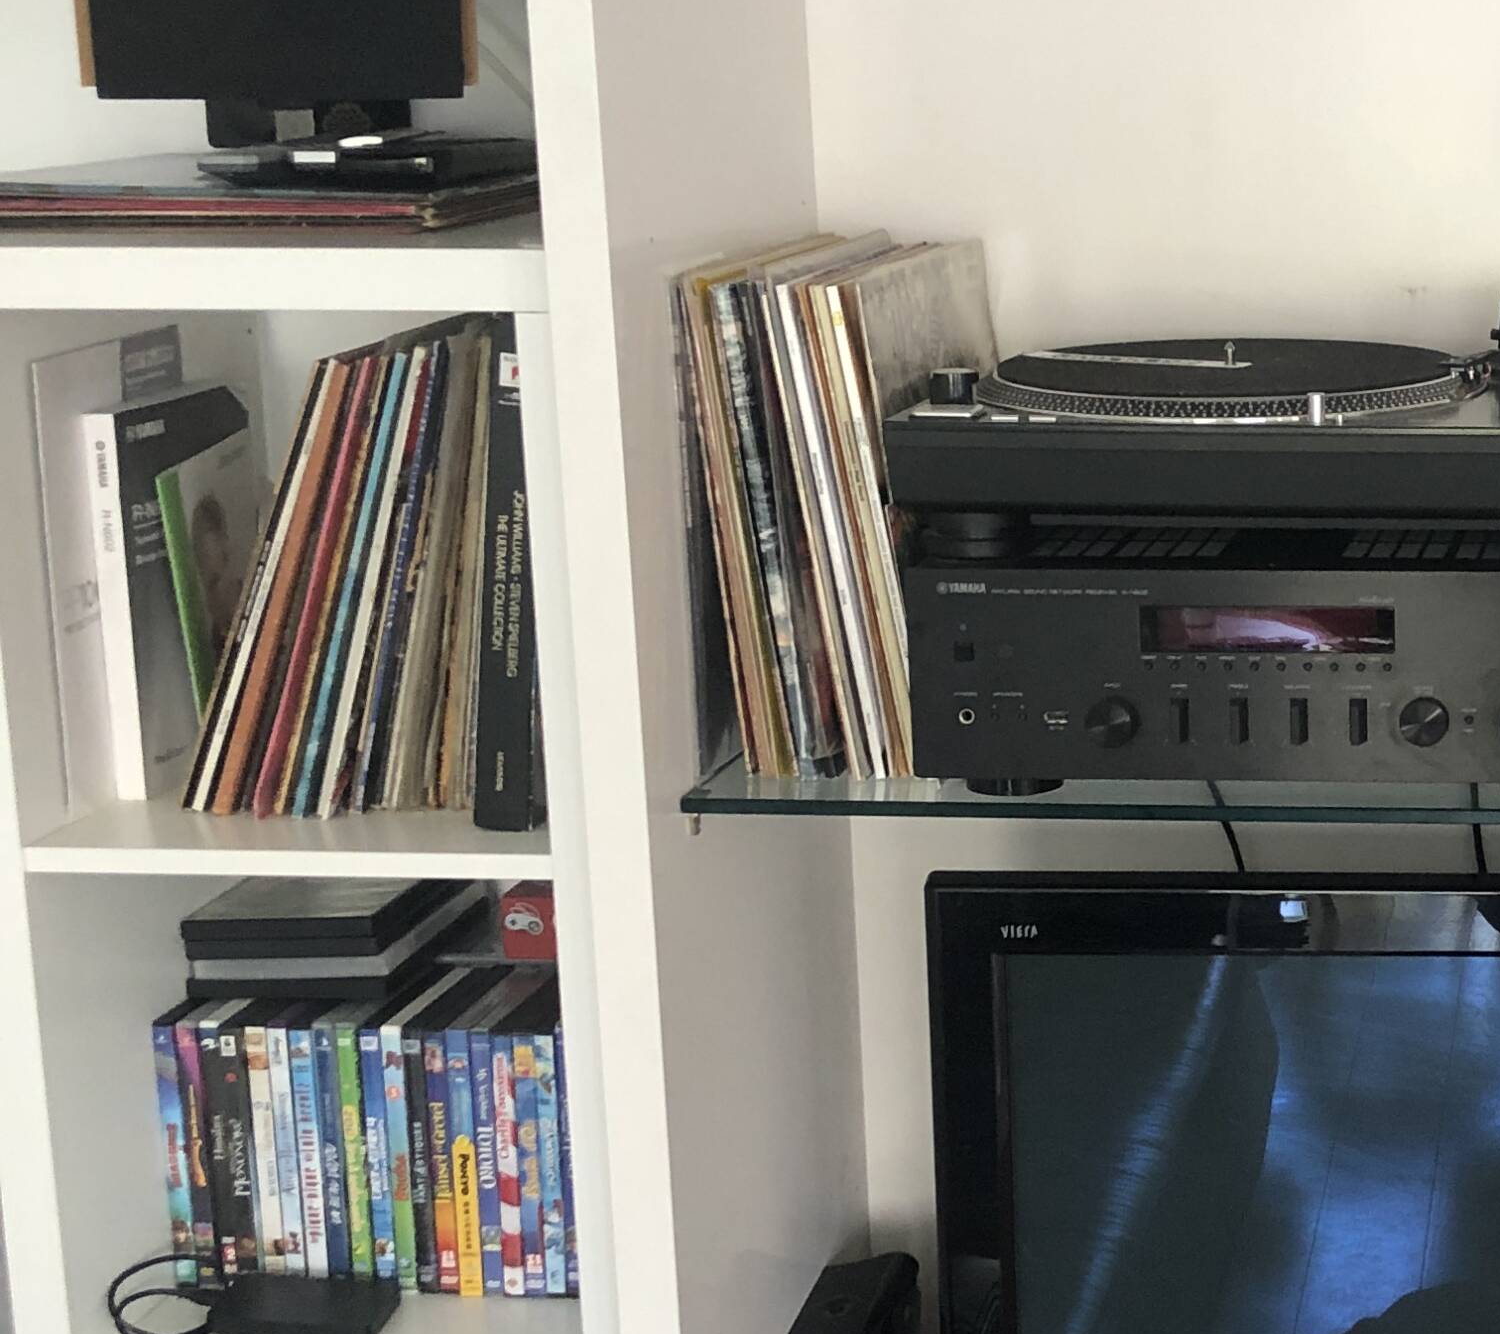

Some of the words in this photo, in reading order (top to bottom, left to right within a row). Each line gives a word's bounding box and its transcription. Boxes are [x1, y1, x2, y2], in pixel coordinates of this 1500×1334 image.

[497, 514, 509, 533] THE
[513, 490, 525, 522] JOHN
[495, 534, 508, 582] ULTIMATE
[510, 523, 524, 575] WILLIAMS
[508, 582, 522, 622] STEVEN
[948, 582, 987, 595] YAMAHA
[491, 583, 506, 651] COLLECTION
[506, 622, 520, 678] SPIELBERG
